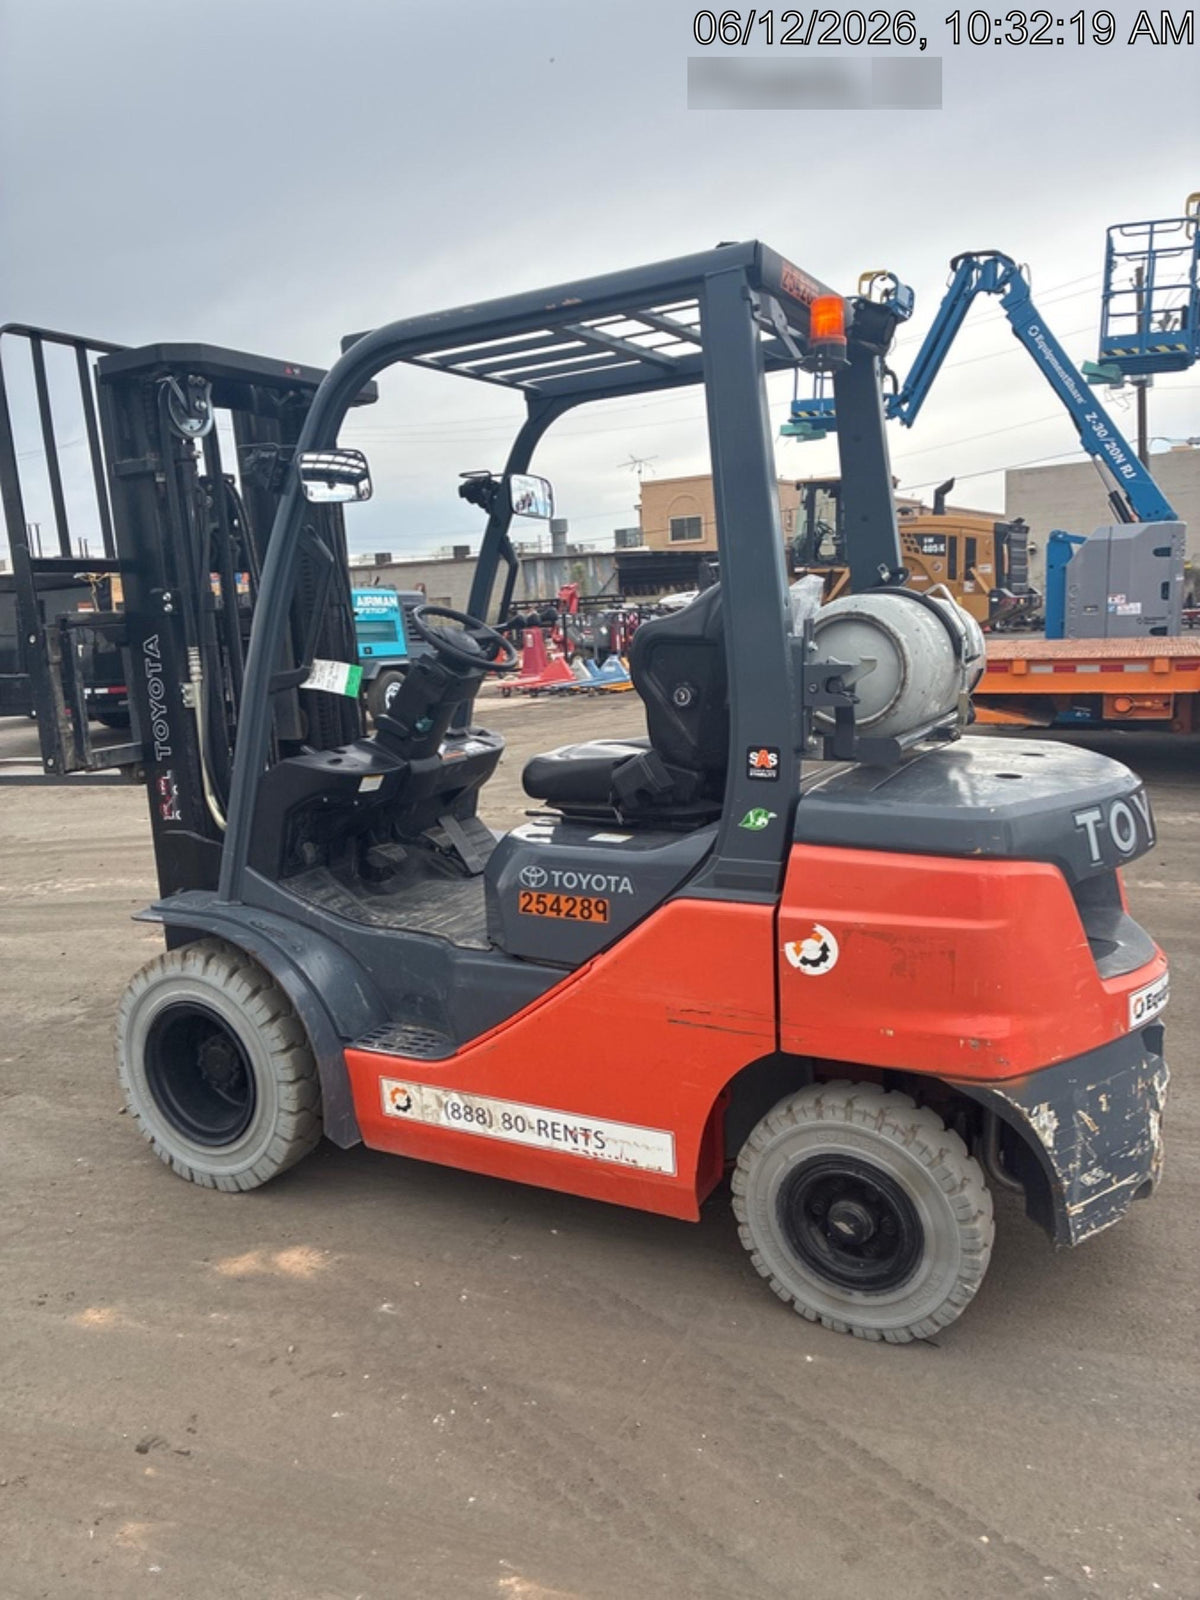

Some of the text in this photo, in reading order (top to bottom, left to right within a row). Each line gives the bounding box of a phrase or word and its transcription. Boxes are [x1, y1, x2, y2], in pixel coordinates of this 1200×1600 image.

[357, 595, 399, 607] AIRMAN
[143, 634, 172, 762] TOYOTA
[749, 749, 778, 769] SAS
[550, 870, 634, 895] TOYOTA
[520, 891, 608, 922] 254289
[444, 1099, 494, 1129] (888)
[501, 1111, 607, 1150] 80-RENTS
